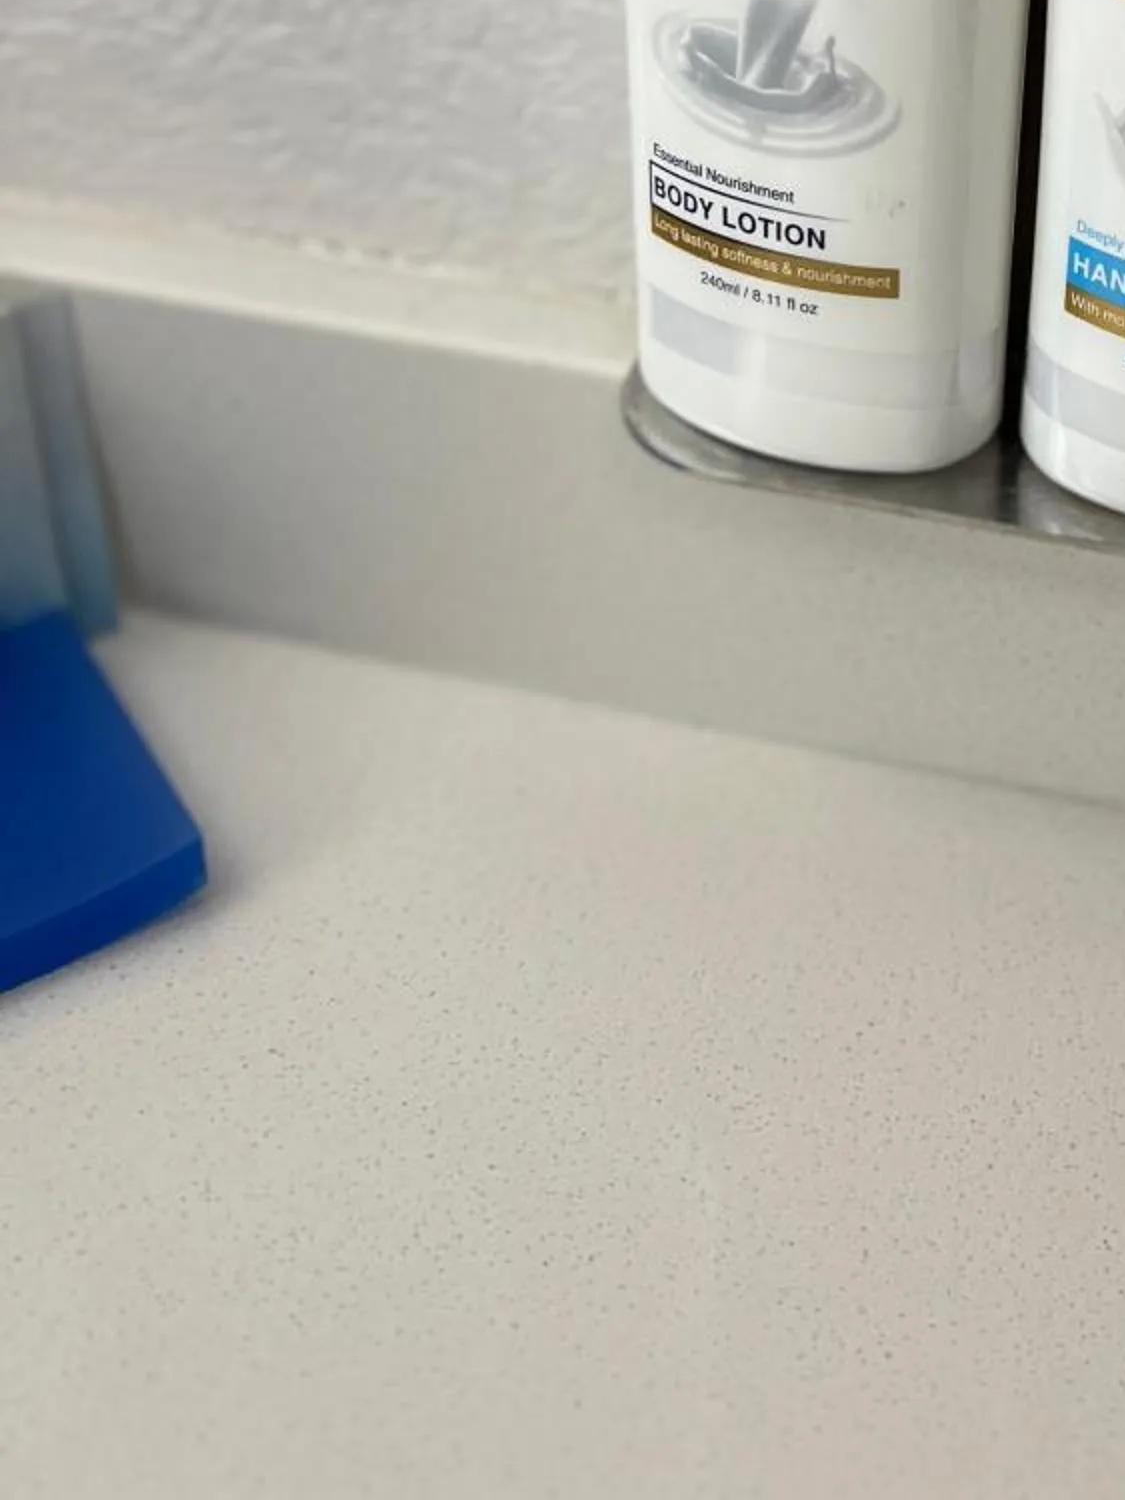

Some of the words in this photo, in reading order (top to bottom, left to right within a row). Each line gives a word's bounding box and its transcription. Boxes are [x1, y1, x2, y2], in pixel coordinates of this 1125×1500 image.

[653, 142, 703, 177] Essential
[706, 167, 795, 204] Nourishment
[654, 176, 714, 219] BODY
[722, 206, 825, 250] LOTION
[1077, 219, 1125, 252] Deeply
[655, 213, 680, 241] Long
[681, 227, 720, 259] lasting
[721, 246, 779, 273] softness
[781, 260, 792, 275] &
[797, 265, 892, 290] nourishment
[700, 270, 741, 296] 240ml
[751, 288, 781, 308] 8.11
[787, 296, 796, 311] fl
[800, 302, 819, 315] oz
[1071, 292, 1100, 317] With
